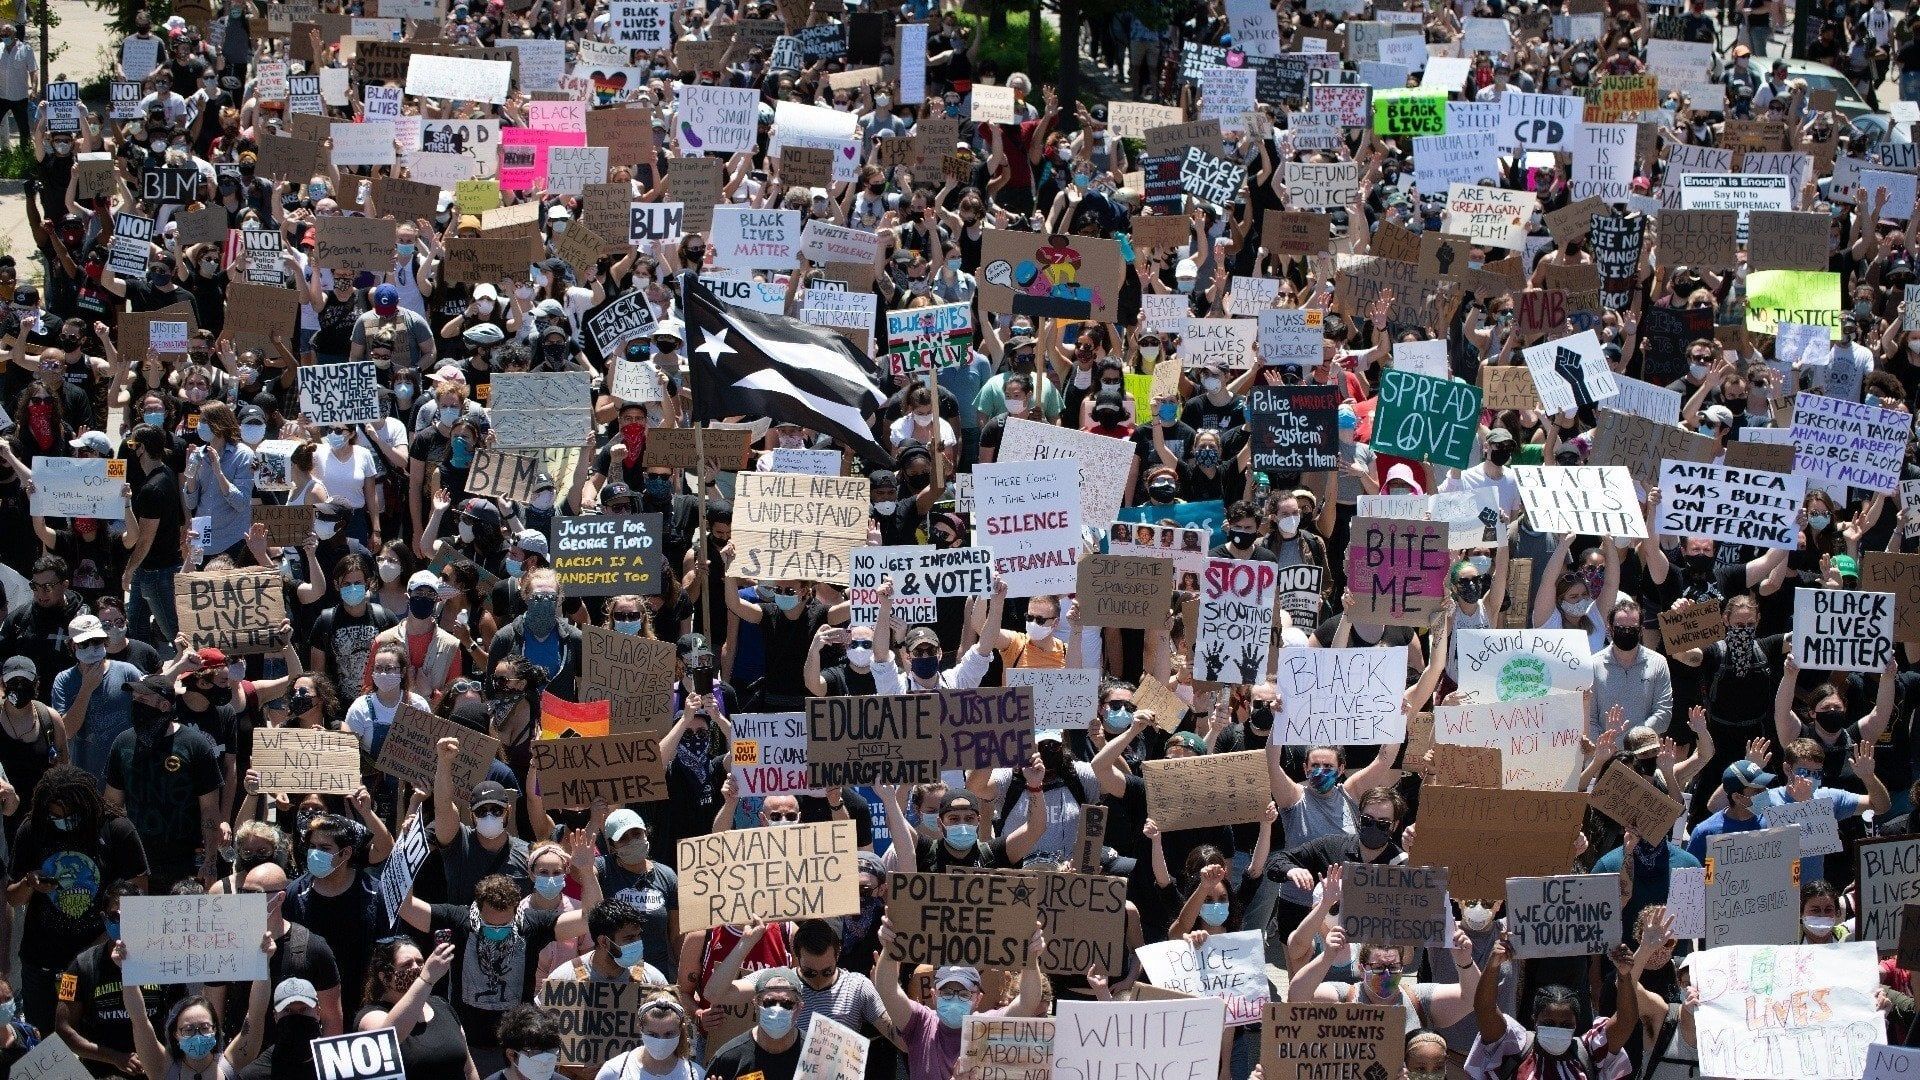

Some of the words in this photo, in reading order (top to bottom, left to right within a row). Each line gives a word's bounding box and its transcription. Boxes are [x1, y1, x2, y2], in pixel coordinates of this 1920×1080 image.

[623, 8, 658, 16] BLACK
[624, 18, 656, 28] LIVES
[621, 30, 660, 41] MATTER
[49, 84, 76, 100] NO!
[112, 84, 138, 100] NO!
[290, 78, 318, 94] NO!
[1388, 105, 1436, 118] BLACK
[1389, 119, 1442, 132] LIVES
[1514, 120, 1564, 144] CPD
[1584, 128, 1626, 145] THIS
[1188, 146, 1244, 183] BLACK
[1598, 148, 1608, 164] IS
[1882, 147, 1916, 166] BLM
[1182, 160, 1234, 192] LIVES
[1290, 166, 1356, 181] DEFUND
[1589, 166, 1618, 180] THE
[1685, 177, 1726, 187] Enough
[146, 174, 196, 199] BLM
[1290, 187, 1356, 205] POLICE
[1458, 188, 1484, 201] ARE
[1490, 190, 1514, 201] WE
[1714, 191, 1730, 199] Say
[120, 217, 150, 239] NO!
[632, 208, 680, 239] BLM
[740, 214, 784, 227] BLACK
[1591, 214, 1627, 232] STILL
[245, 232, 278, 250] NO!
[741, 230, 785, 241] LIVES
[1591, 230, 1614, 248] SEE
[1622, 232, 1639, 248] NO
[597, 296, 640, 330] FUCK
[1774, 309, 1840, 326] JUSTICE
[598, 308, 649, 346] TRUMP
[889, 314, 920, 334] BLUE
[300, 362, 375, 381] INJUSTICE
[892, 348, 941, 374] BLACK
[300, 378, 373, 394] ANYWHERE
[312, 394, 320, 404] IS
[340, 390, 377, 399] THREAT
[319, 401, 333, 410] TO
[337, 398, 373, 409] JUSTICE
[1254, 390, 1290, 411] Police
[1382, 372, 1475, 422] SPREAD
[1277, 412, 1308, 426] The
[1797, 394, 1871, 420] JUSTICE
[1879, 409, 1910, 428] FOR
[1376, 406, 1469, 460] LOVE
[1254, 448, 1303, 468] protects
[1668, 464, 1785, 491] AMERICA
[760, 476, 804, 498] WILL
[810, 478, 866, 501] NEVER
[1675, 484, 1720, 498] WAS
[1731, 490, 1798, 511] BUILT
[748, 502, 862, 527] UNDERSTAND
[988, 512, 1068, 535] SILENCE
[1673, 500, 1704, 512] ON
[1716, 504, 1787, 526] BLACK
[559, 520, 614, 535] JUSTICE
[1663, 512, 1792, 544] SUFFERING
[559, 537, 608, 550] GEORGE
[614, 537, 652, 548] FLOYD
[770, 528, 802, 550] BUT
[1366, 528, 1440, 570] BITE
[742, 548, 842, 577] STAND
[888, 560, 912, 572] GET
[920, 550, 990, 568] INFORMED
[901, 572, 919, 595] &
[925, 567, 992, 595] VOTE!
[1204, 562, 1275, 599] STOP
[491, 576, 578, 609] BLACK
[1373, 577, 1421, 613] ME
[1204, 601, 1271, 622] SHOOTING
[1814, 592, 1886, 616] BLACK
[496, 606, 570, 630] LIVES
[1816, 615, 1881, 638] LIVES
[1803, 636, 1891, 668] MATTER
[1284, 654, 1392, 694] BLACK
[1309, 696, 1395, 710] LIVES
[811, 696, 932, 741] EDUCATE
[1284, 716, 1394, 742] MATTER
[861, 744, 885, 754] NOT
[680, 824, 848, 871] DISMANTLE
[694, 856, 842, 896] SYSTEMIC
[893, 878, 1006, 900] POLICE
[710, 886, 824, 925] RACISM
[1515, 905, 1540, 923] WE
[1544, 902, 1612, 922] COMING
[922, 906, 995, 933] FREE
[890, 933, 1027, 966] SCHOOLS!
[1290, 1008, 1338, 1022] STAND
[1346, 1009, 1384, 1020] WITH
[1276, 1026, 1300, 1038] MY
[1317, 1025, 1384, 1040] STUDENTS
[1279, 1044, 1327, 1059] BLACK
[1332, 1044, 1376, 1059] LIVES
